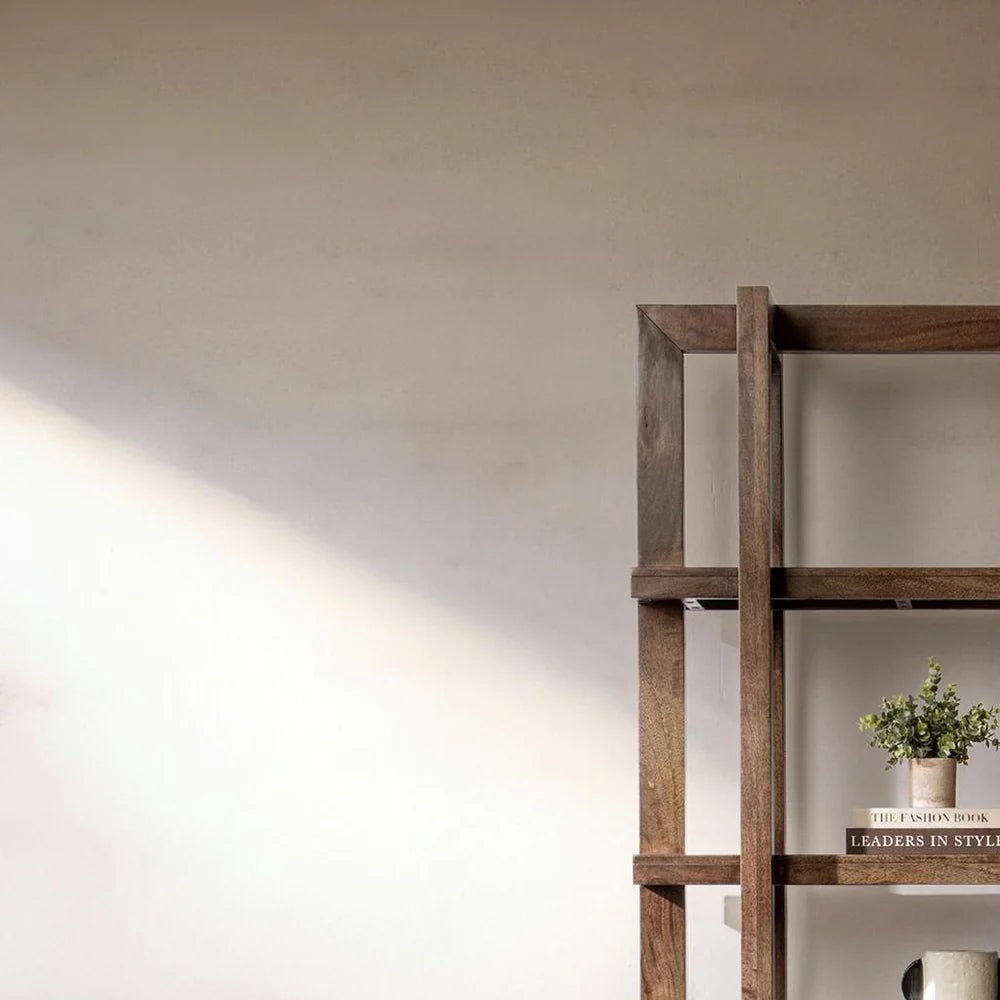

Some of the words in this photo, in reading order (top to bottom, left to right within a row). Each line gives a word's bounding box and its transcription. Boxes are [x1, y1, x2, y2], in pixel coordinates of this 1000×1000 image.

[872, 813, 897, 823] THE
[955, 813, 989, 823] BOOK
[851, 835, 925, 847] LEADERS
[930, 835, 948, 847] IN
